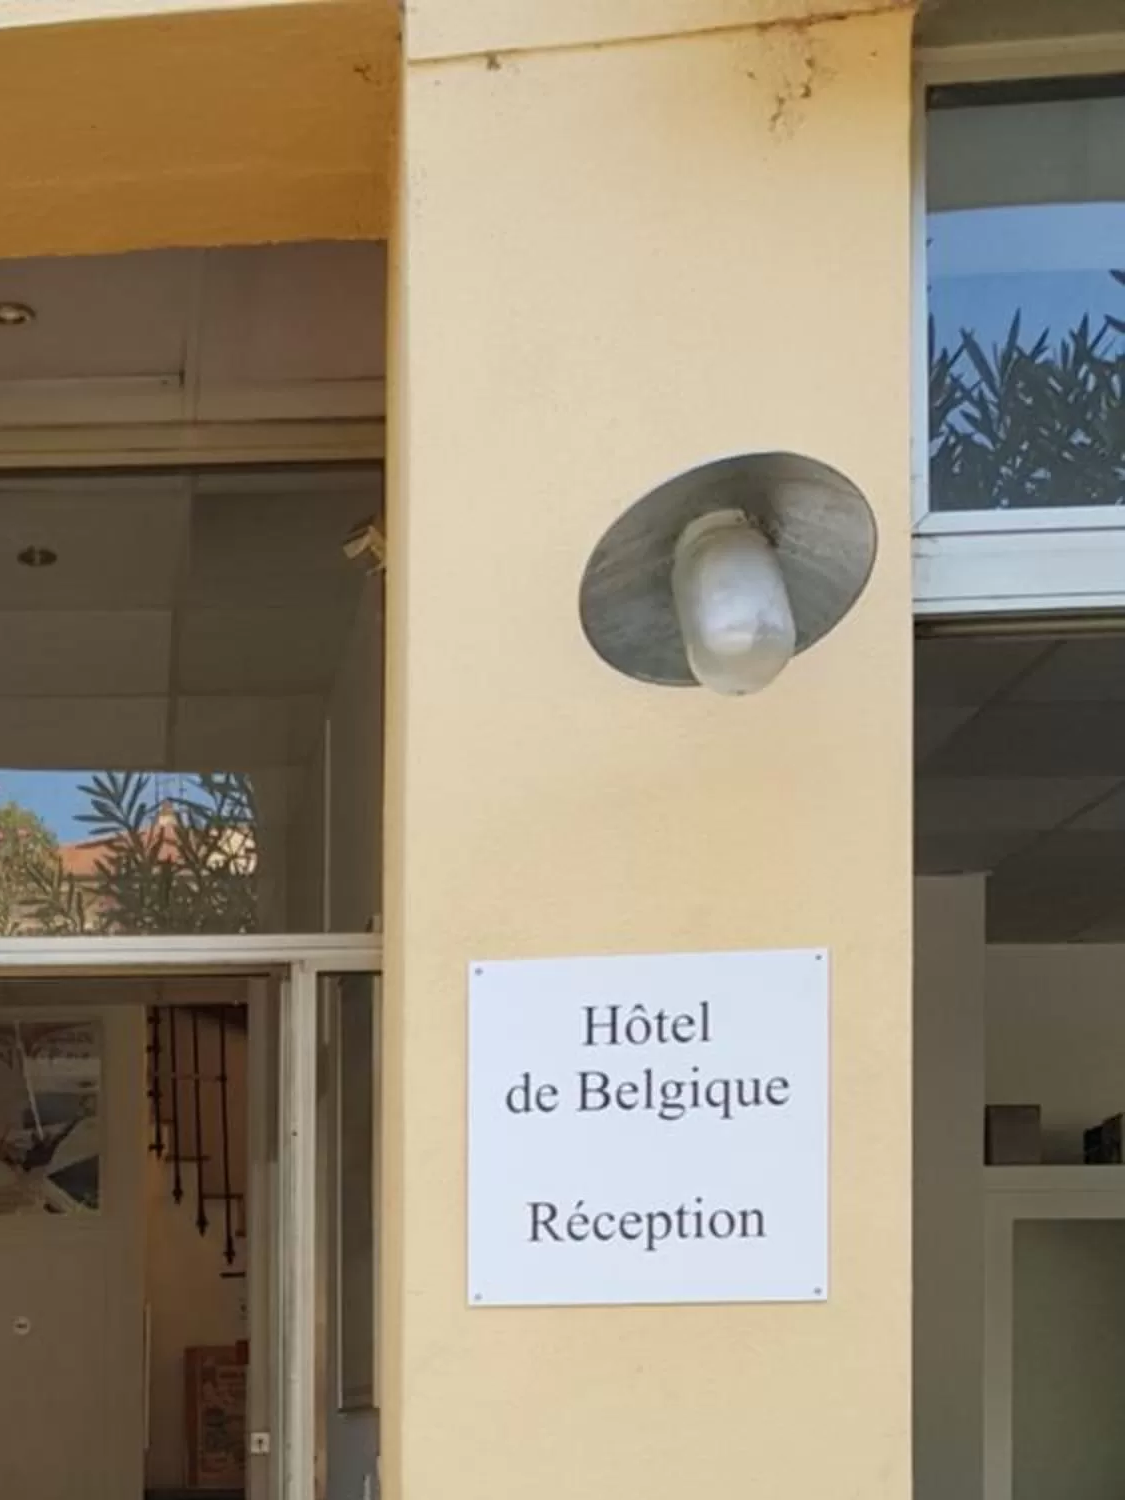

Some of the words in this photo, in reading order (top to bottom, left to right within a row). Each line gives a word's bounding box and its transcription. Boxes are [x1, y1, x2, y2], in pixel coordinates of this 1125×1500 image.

[584, 1000, 709, 1046] Hôtel
[505, 1071, 559, 1114] de
[578, 1066, 790, 1121] Belgique
[530, 1197, 765, 1252] Réception
